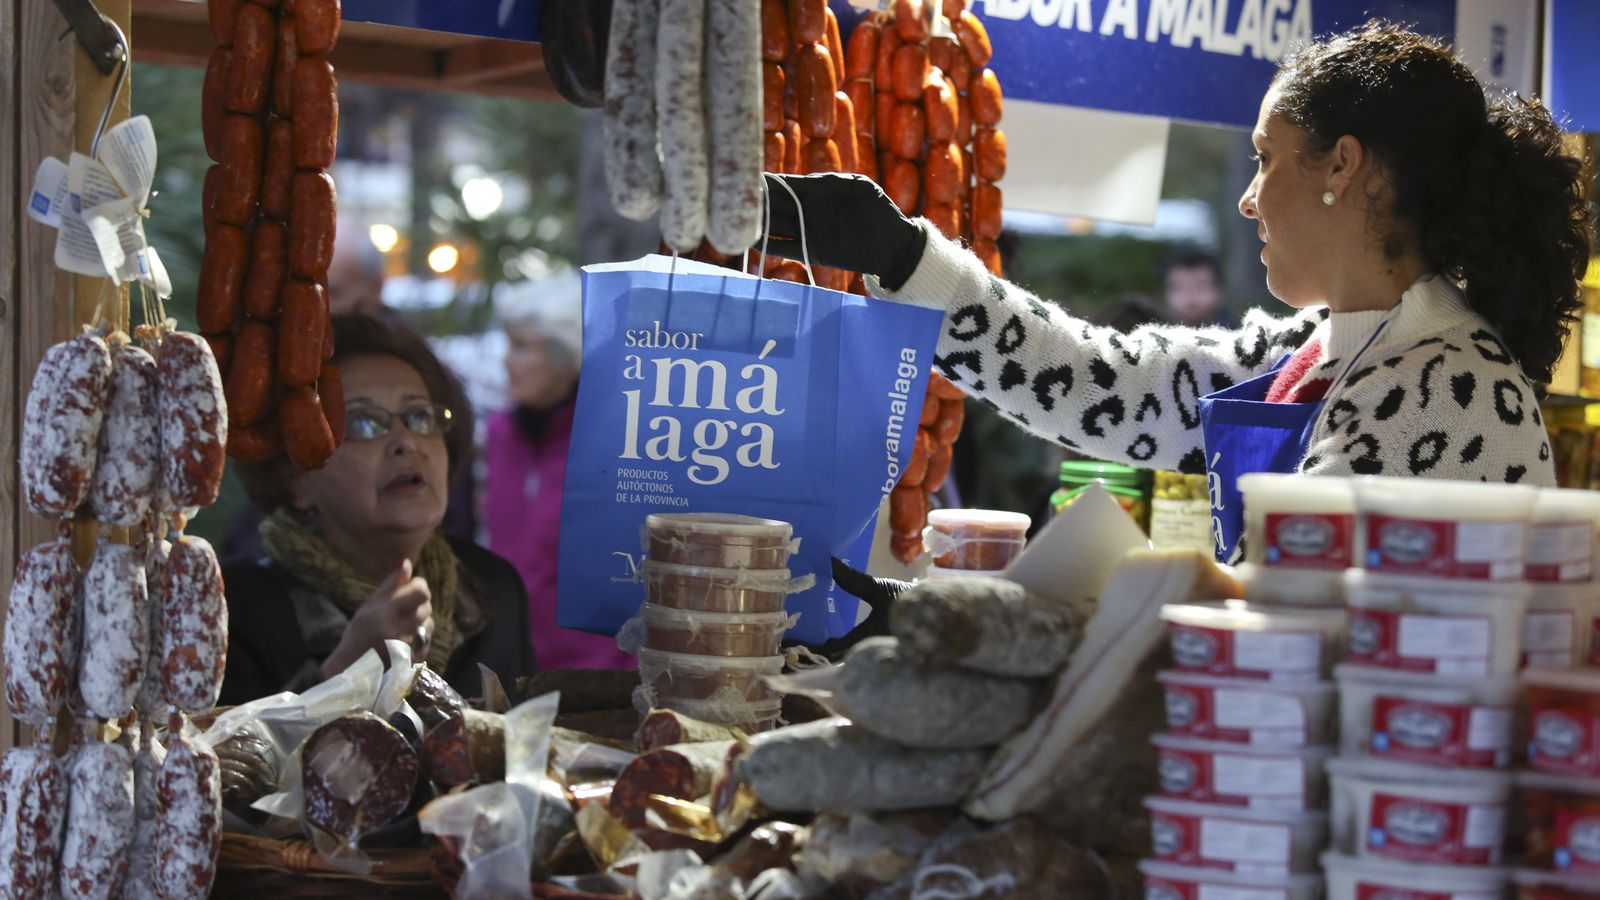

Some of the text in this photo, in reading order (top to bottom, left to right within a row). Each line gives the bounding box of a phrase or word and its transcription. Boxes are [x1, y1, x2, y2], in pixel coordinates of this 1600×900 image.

[1099, 0, 1138, 40] A
[625, 320, 704, 351] sabor
[623, 339, 786, 416] a má
[618, 389, 781, 485] laga
[616, 480, 674, 494] AUTÓCTONOS
[617, 468, 669, 481] PRODUCTOS
[616, 493, 689, 507] DE LA PROVINCIA
